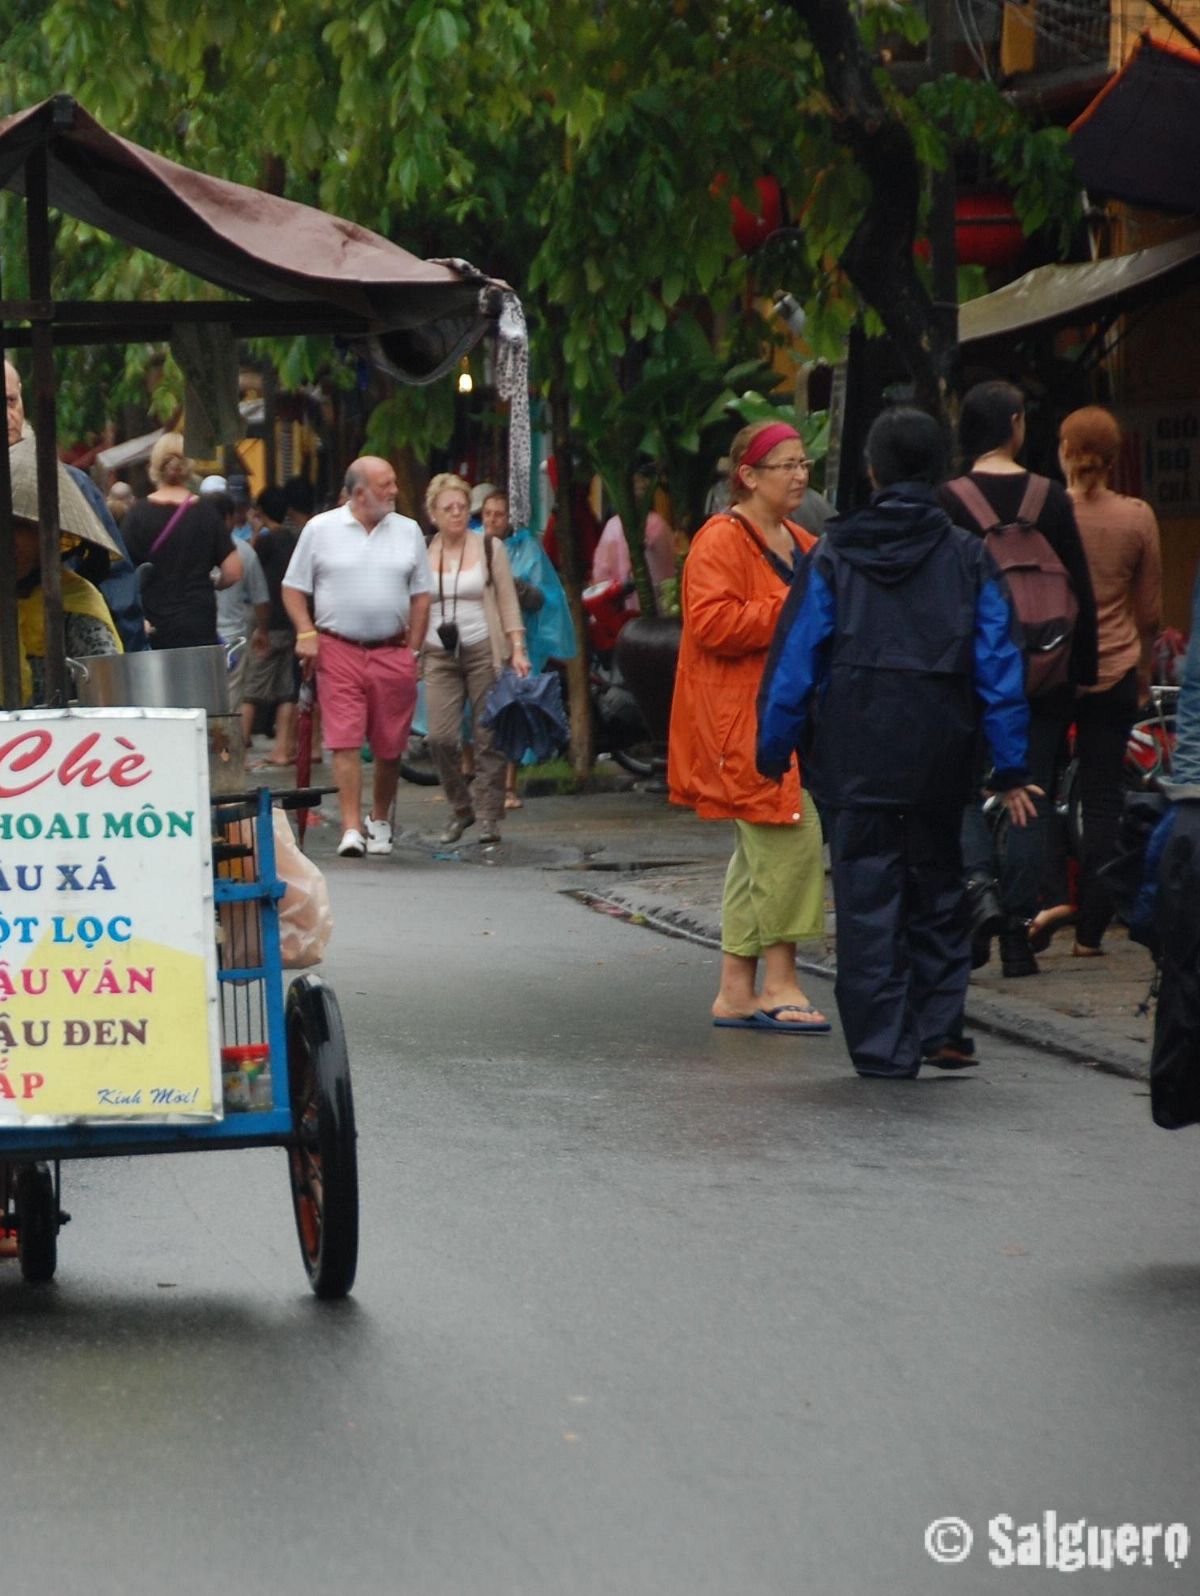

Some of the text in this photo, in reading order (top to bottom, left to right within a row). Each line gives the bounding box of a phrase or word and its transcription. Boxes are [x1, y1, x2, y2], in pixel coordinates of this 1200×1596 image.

[103, 804, 195, 838] MÔN
[56, 856, 116, 891] XÁ
[52, 915, 132, 948] LỌC
[62, 960, 154, 994] VÁN
[64, 1019, 148, 1046] ĐEN
